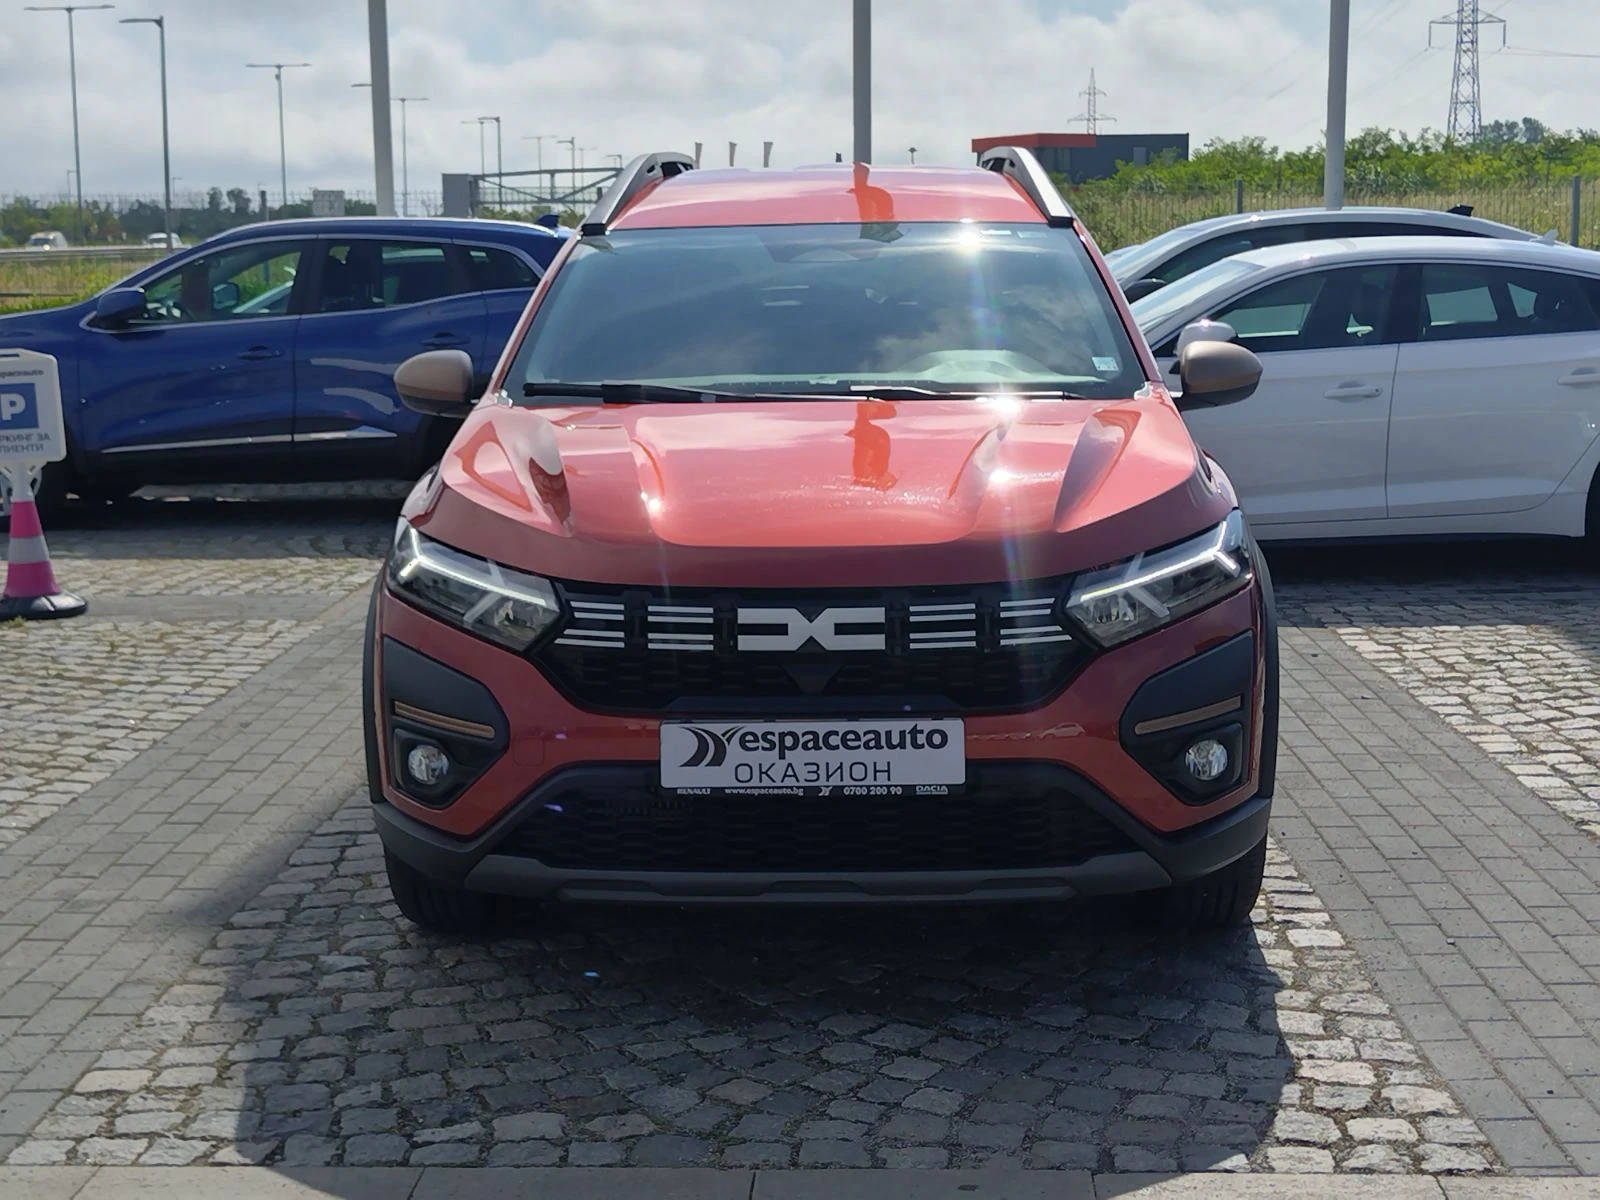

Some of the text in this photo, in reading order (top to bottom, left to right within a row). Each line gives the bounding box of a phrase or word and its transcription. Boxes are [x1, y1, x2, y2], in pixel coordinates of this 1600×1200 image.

[1, 393, 26, 421] P
[738, 723, 949, 760] espaceauto
[734, 761, 891, 783] ОКАЗИОН
[724, 786, 804, 796] www.espaceauto.bg
[843, 786, 903, 795] 0700 200 90
[915, 785, 948, 795] DACIA
